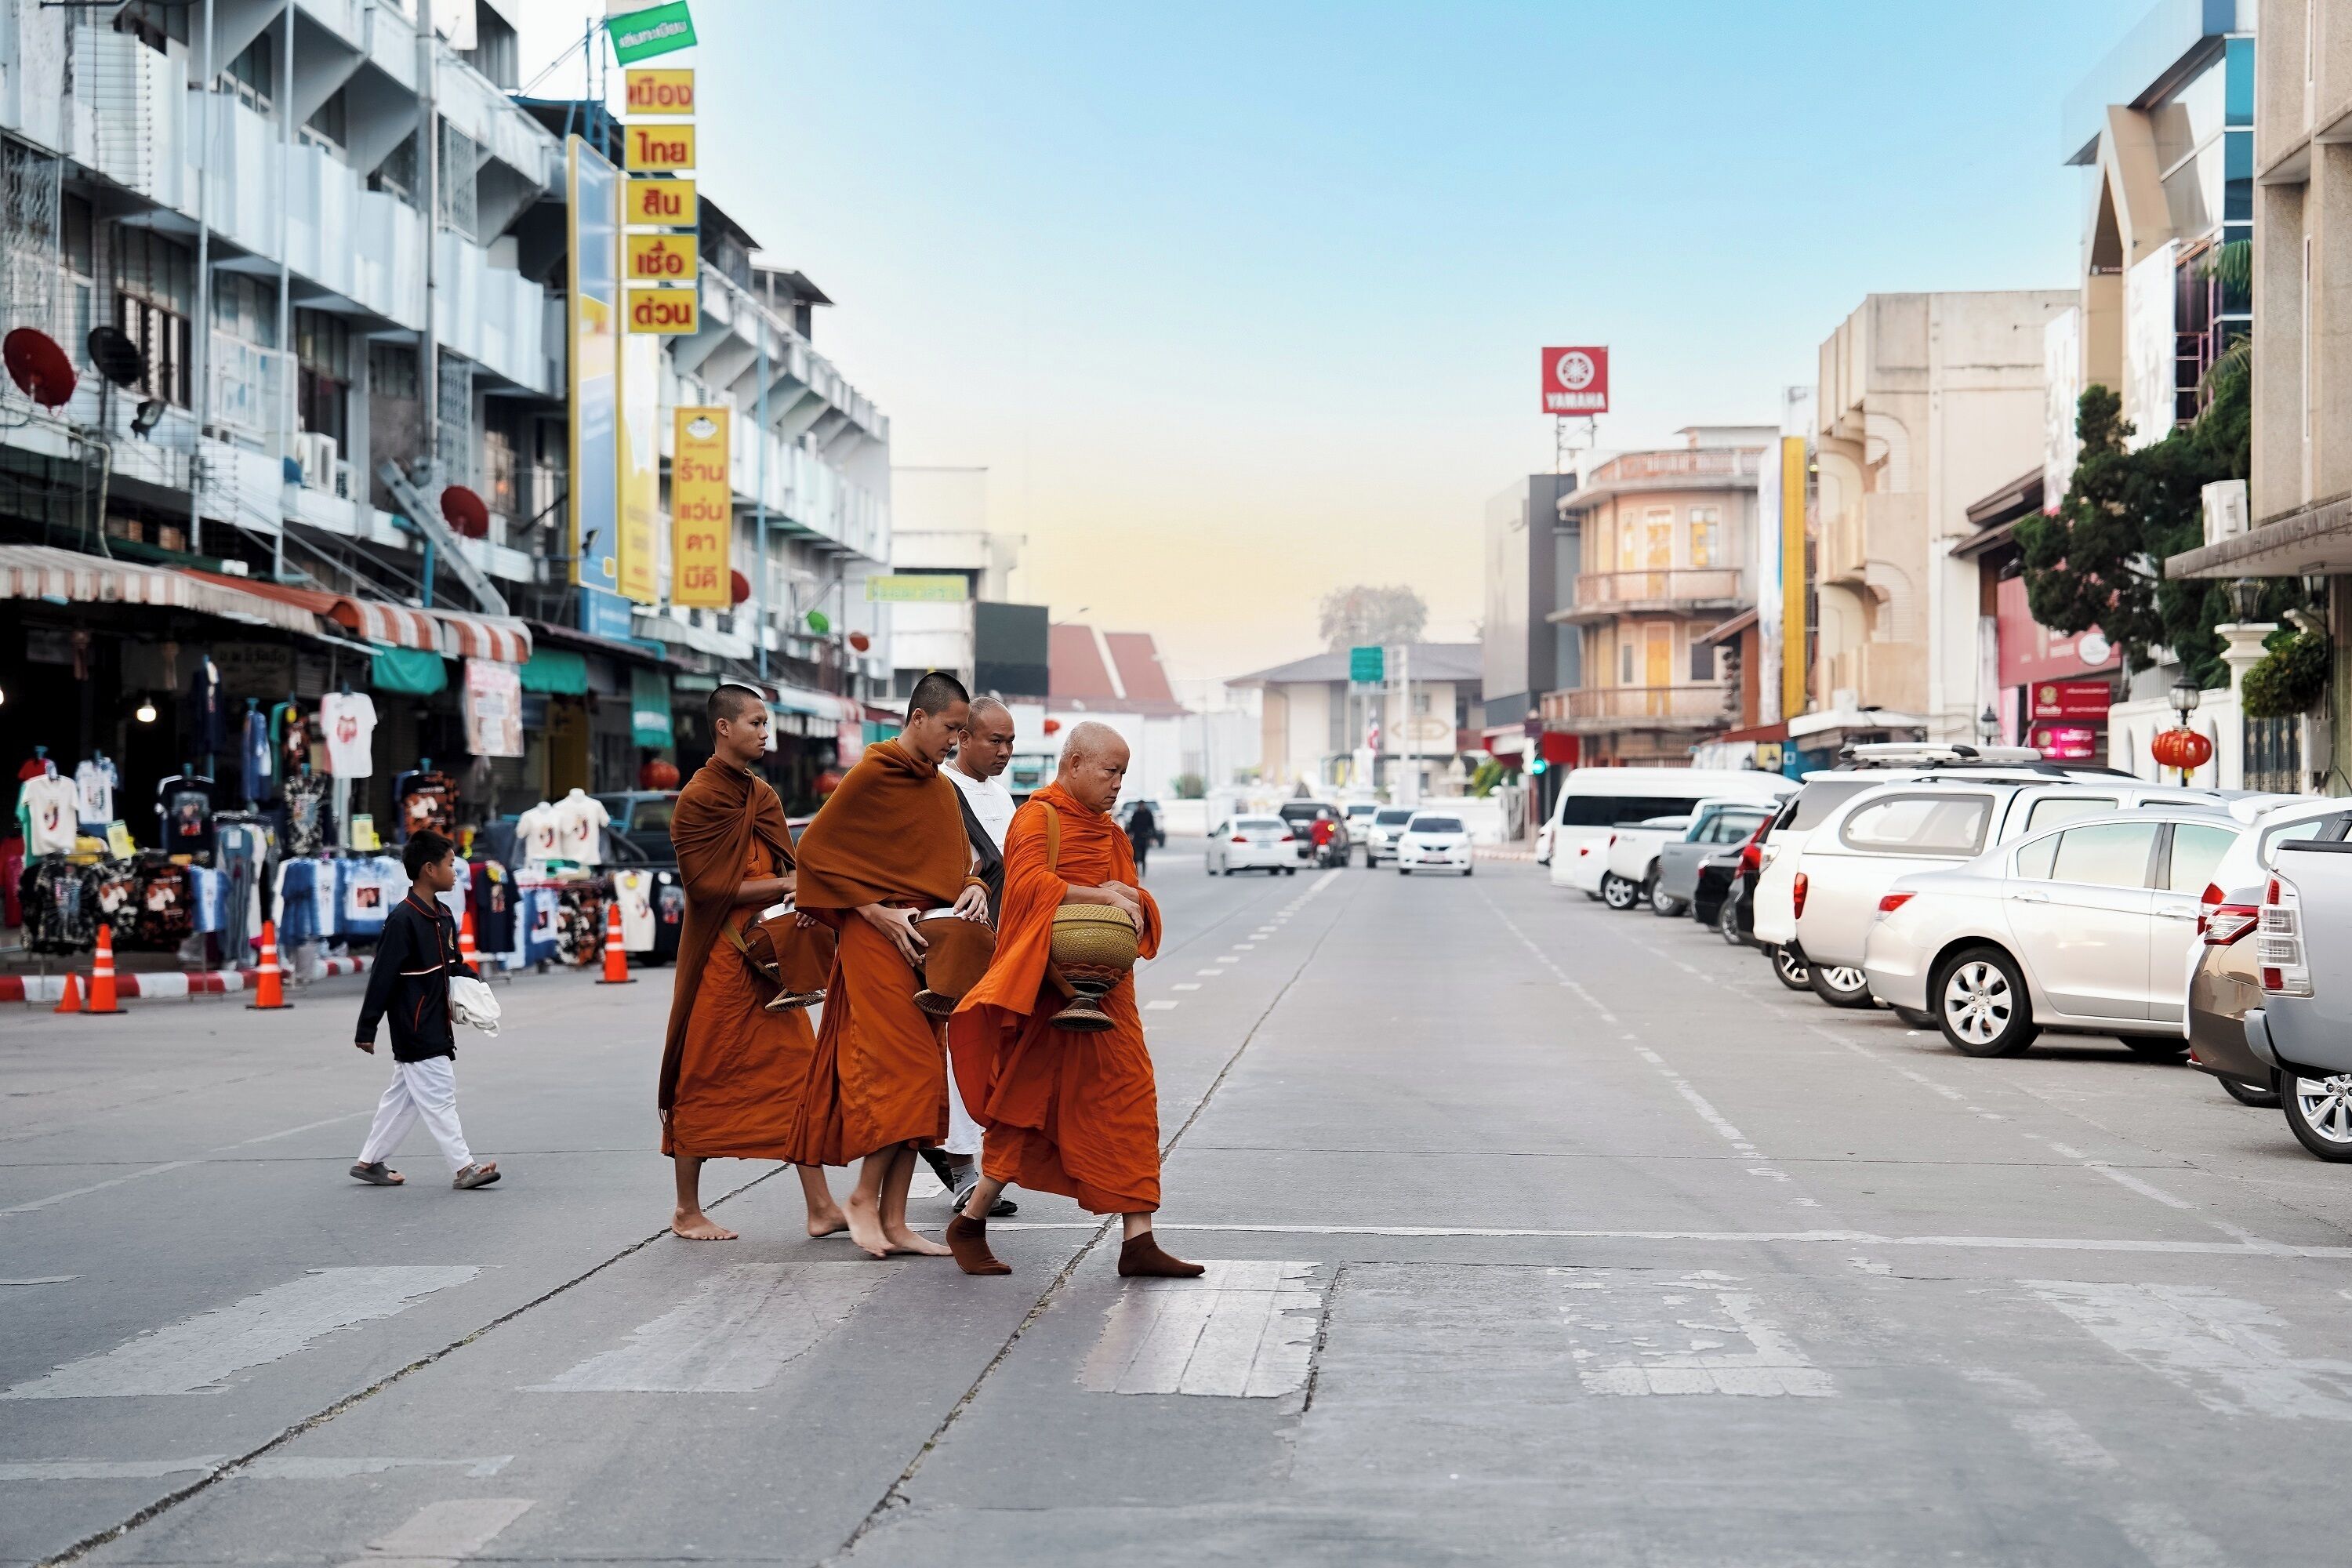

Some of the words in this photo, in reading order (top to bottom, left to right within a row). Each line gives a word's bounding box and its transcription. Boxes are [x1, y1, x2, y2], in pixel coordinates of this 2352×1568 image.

[628, 77, 692, 107] เมือง
[637, 131, 687, 163] ไทย
[637, 241, 684, 275] เชื่อ
[633, 296, 691, 325] ด่วน
[1545, 392, 1606, 410] YAMAHA
[680, 457, 724, 482] ร้าน
[680, 495, 724, 521] แว่น
[685, 533, 717, 552] ตา
